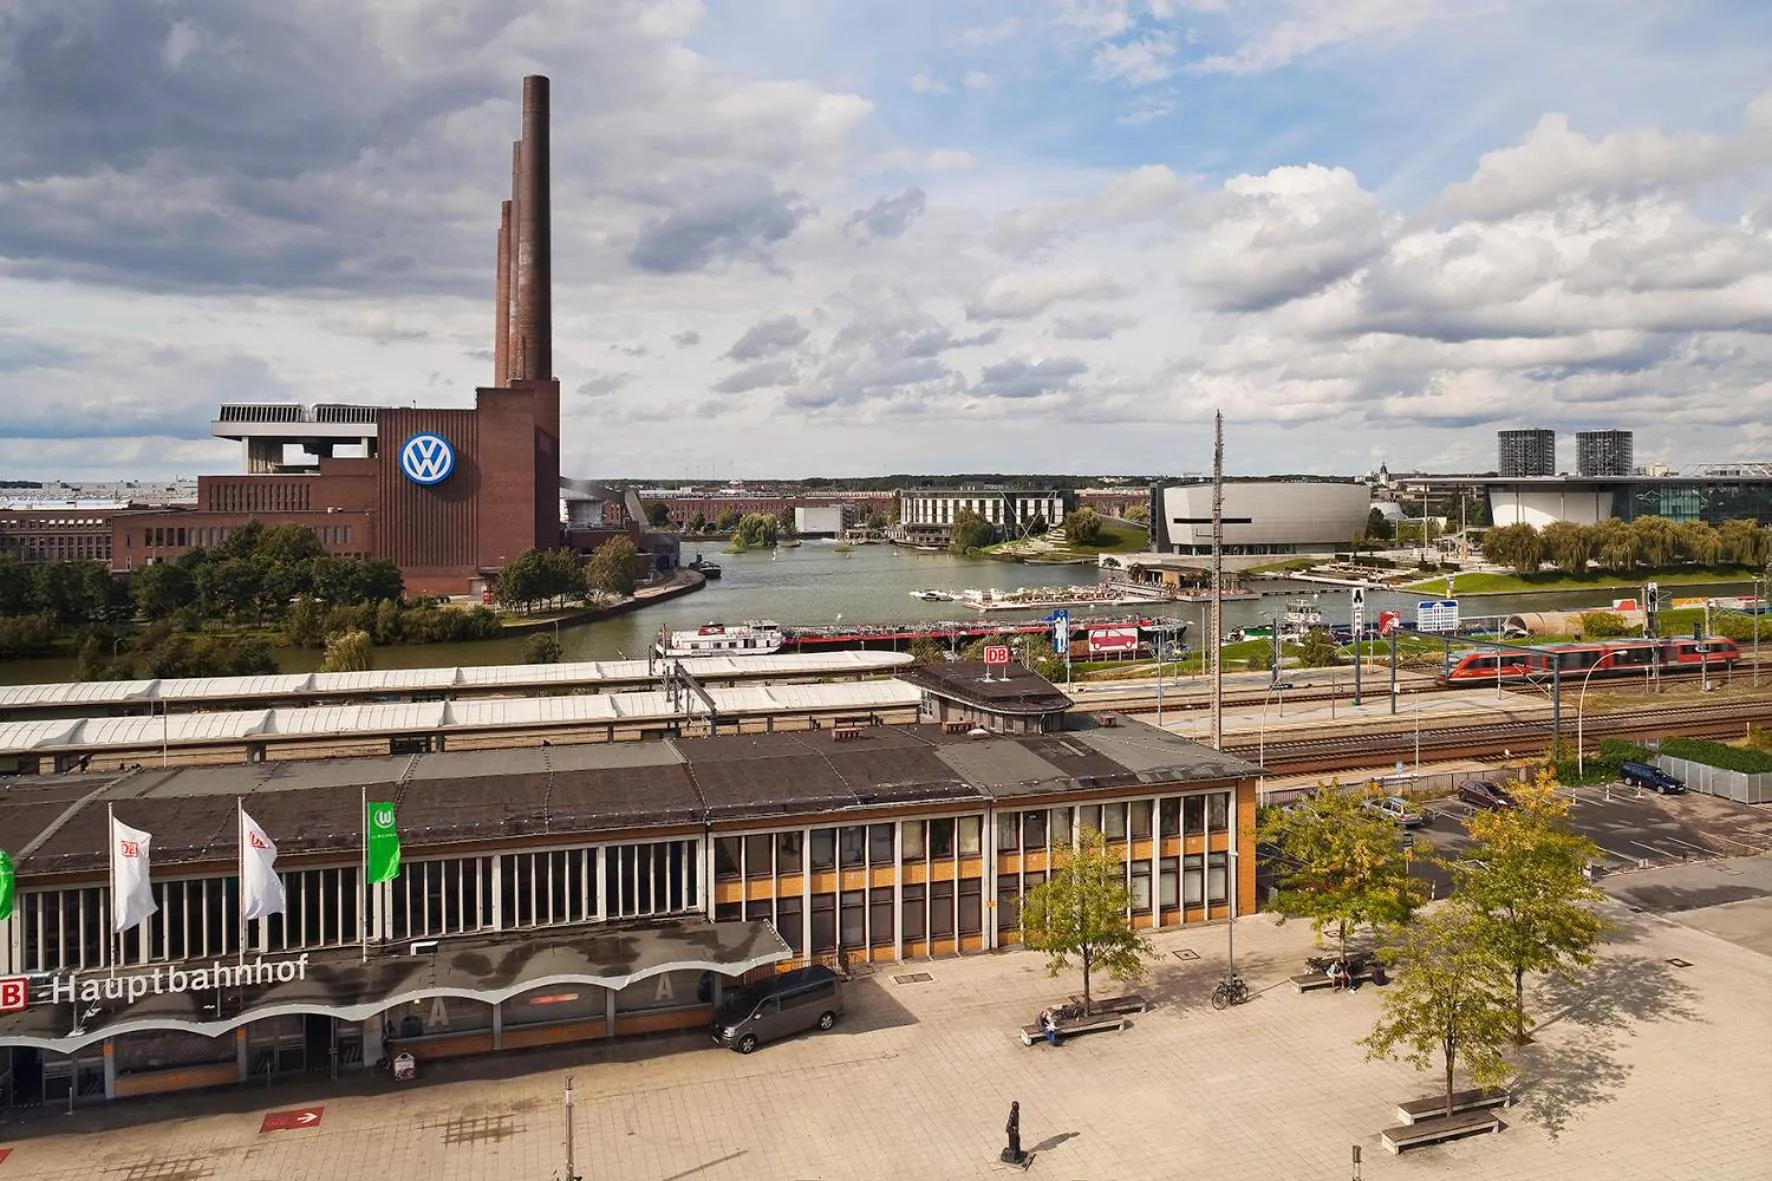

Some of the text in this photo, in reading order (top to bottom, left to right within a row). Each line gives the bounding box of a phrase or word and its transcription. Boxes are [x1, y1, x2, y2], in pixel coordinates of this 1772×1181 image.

[403, 437, 450, 479] VW
[989, 650, 1006, 661] DB
[52, 953, 308, 1004] Hauptbahnhof
